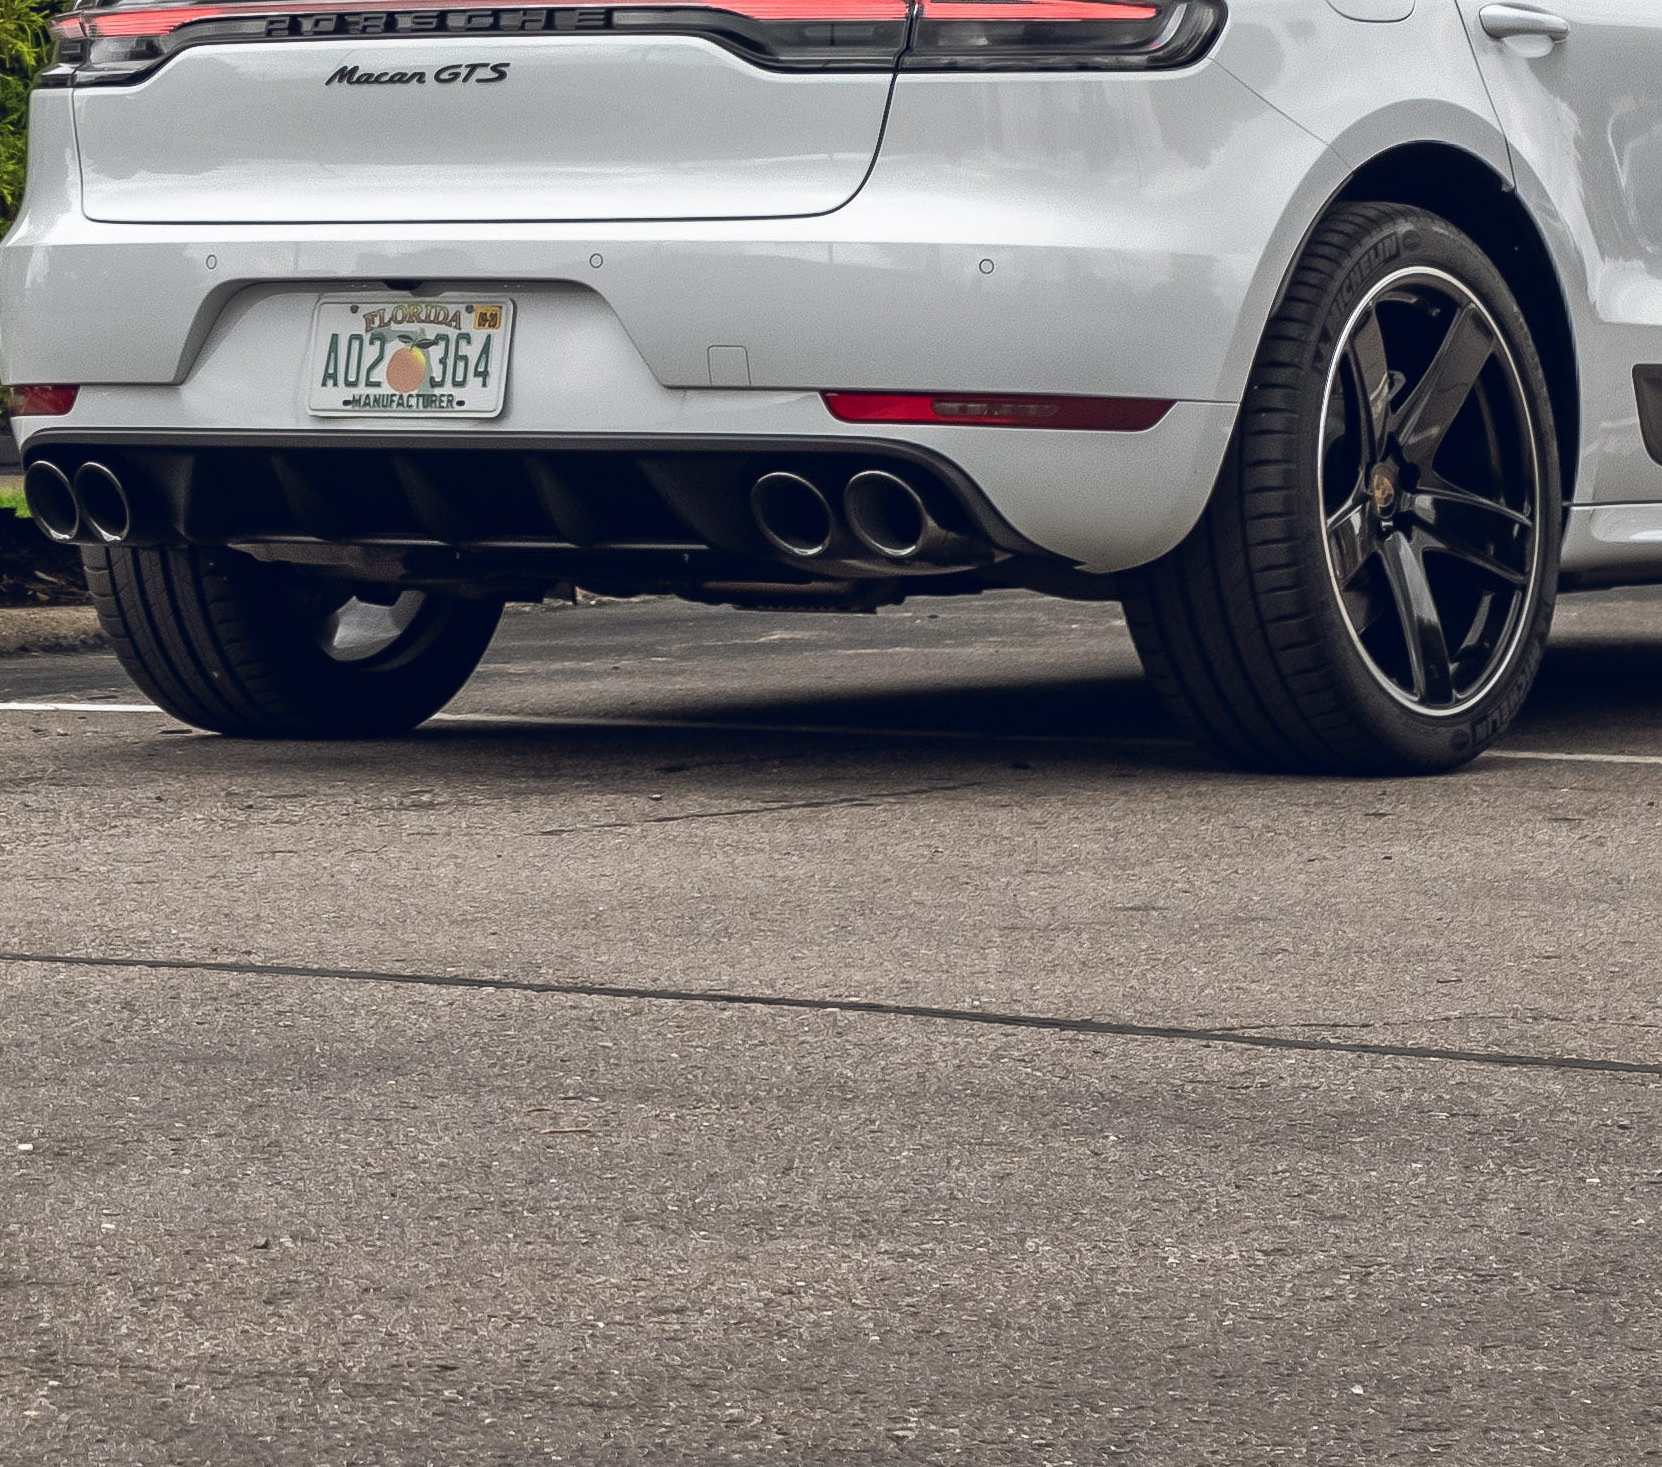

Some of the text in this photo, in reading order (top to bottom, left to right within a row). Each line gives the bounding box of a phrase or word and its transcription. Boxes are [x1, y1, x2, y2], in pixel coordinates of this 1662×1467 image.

[264, 8, 608, 37] PORSCHE
[324, 62, 511, 86] Macan GTS
[362, 303, 463, 333] FLORIDA
[428, 332, 493, 389] 364
[351, 392, 455, 410] MANUFACTURER
